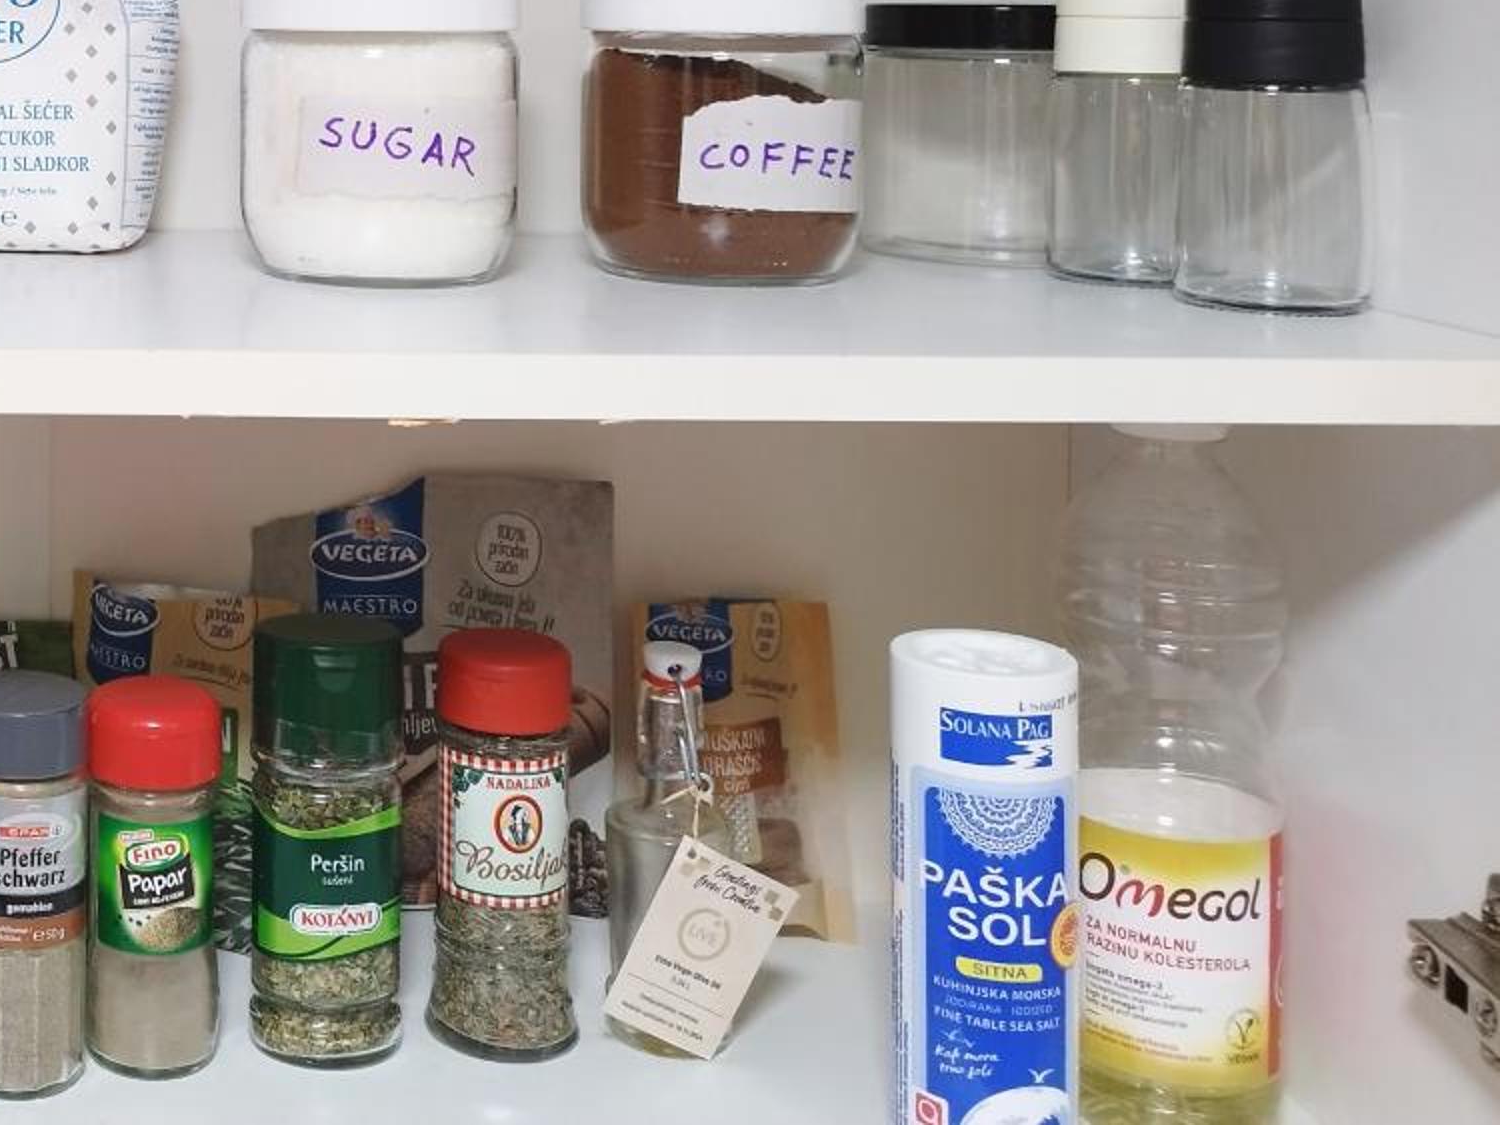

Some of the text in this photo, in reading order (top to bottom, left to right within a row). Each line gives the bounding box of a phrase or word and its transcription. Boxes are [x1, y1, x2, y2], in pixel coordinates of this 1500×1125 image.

[22, 99, 74, 121] ŠEĆER
[318, 116, 477, 178] SUGAR
[699, 140, 856, 180] COFFEE
[13, 155, 91, 173] SLADKOR
[320, 543, 418, 564] VEGETA
[323, 597, 418, 615] MAESTRO
[652, 624, 727, 642] VEGETA
[940, 710, 1049, 740] SOLANA PAG
[485, 775, 552, 790] NADALINA
[0, 848, 61, 868] Pfeffer
[310, 852, 366, 873] Peršin
[128, 866, 187, 895] Papar
[921, 858, 1070, 910] PAŠKA
[1078, 851, 1260, 923] Omegol
[301, 907, 373, 927] KOTÁNYI
[947, 909, 1046, 947] SOL
[1086, 915, 1197, 953] ZA NORMALNU
[1087, 932, 1252, 972] RAZINU KOLESTEROLA
[972, 962, 1028, 979] SITNA
[933, 975, 1061, 1001] KUHINJSKA MORSKA
[933, 1005, 1061, 1032] FINE TABLE SEA SALT
